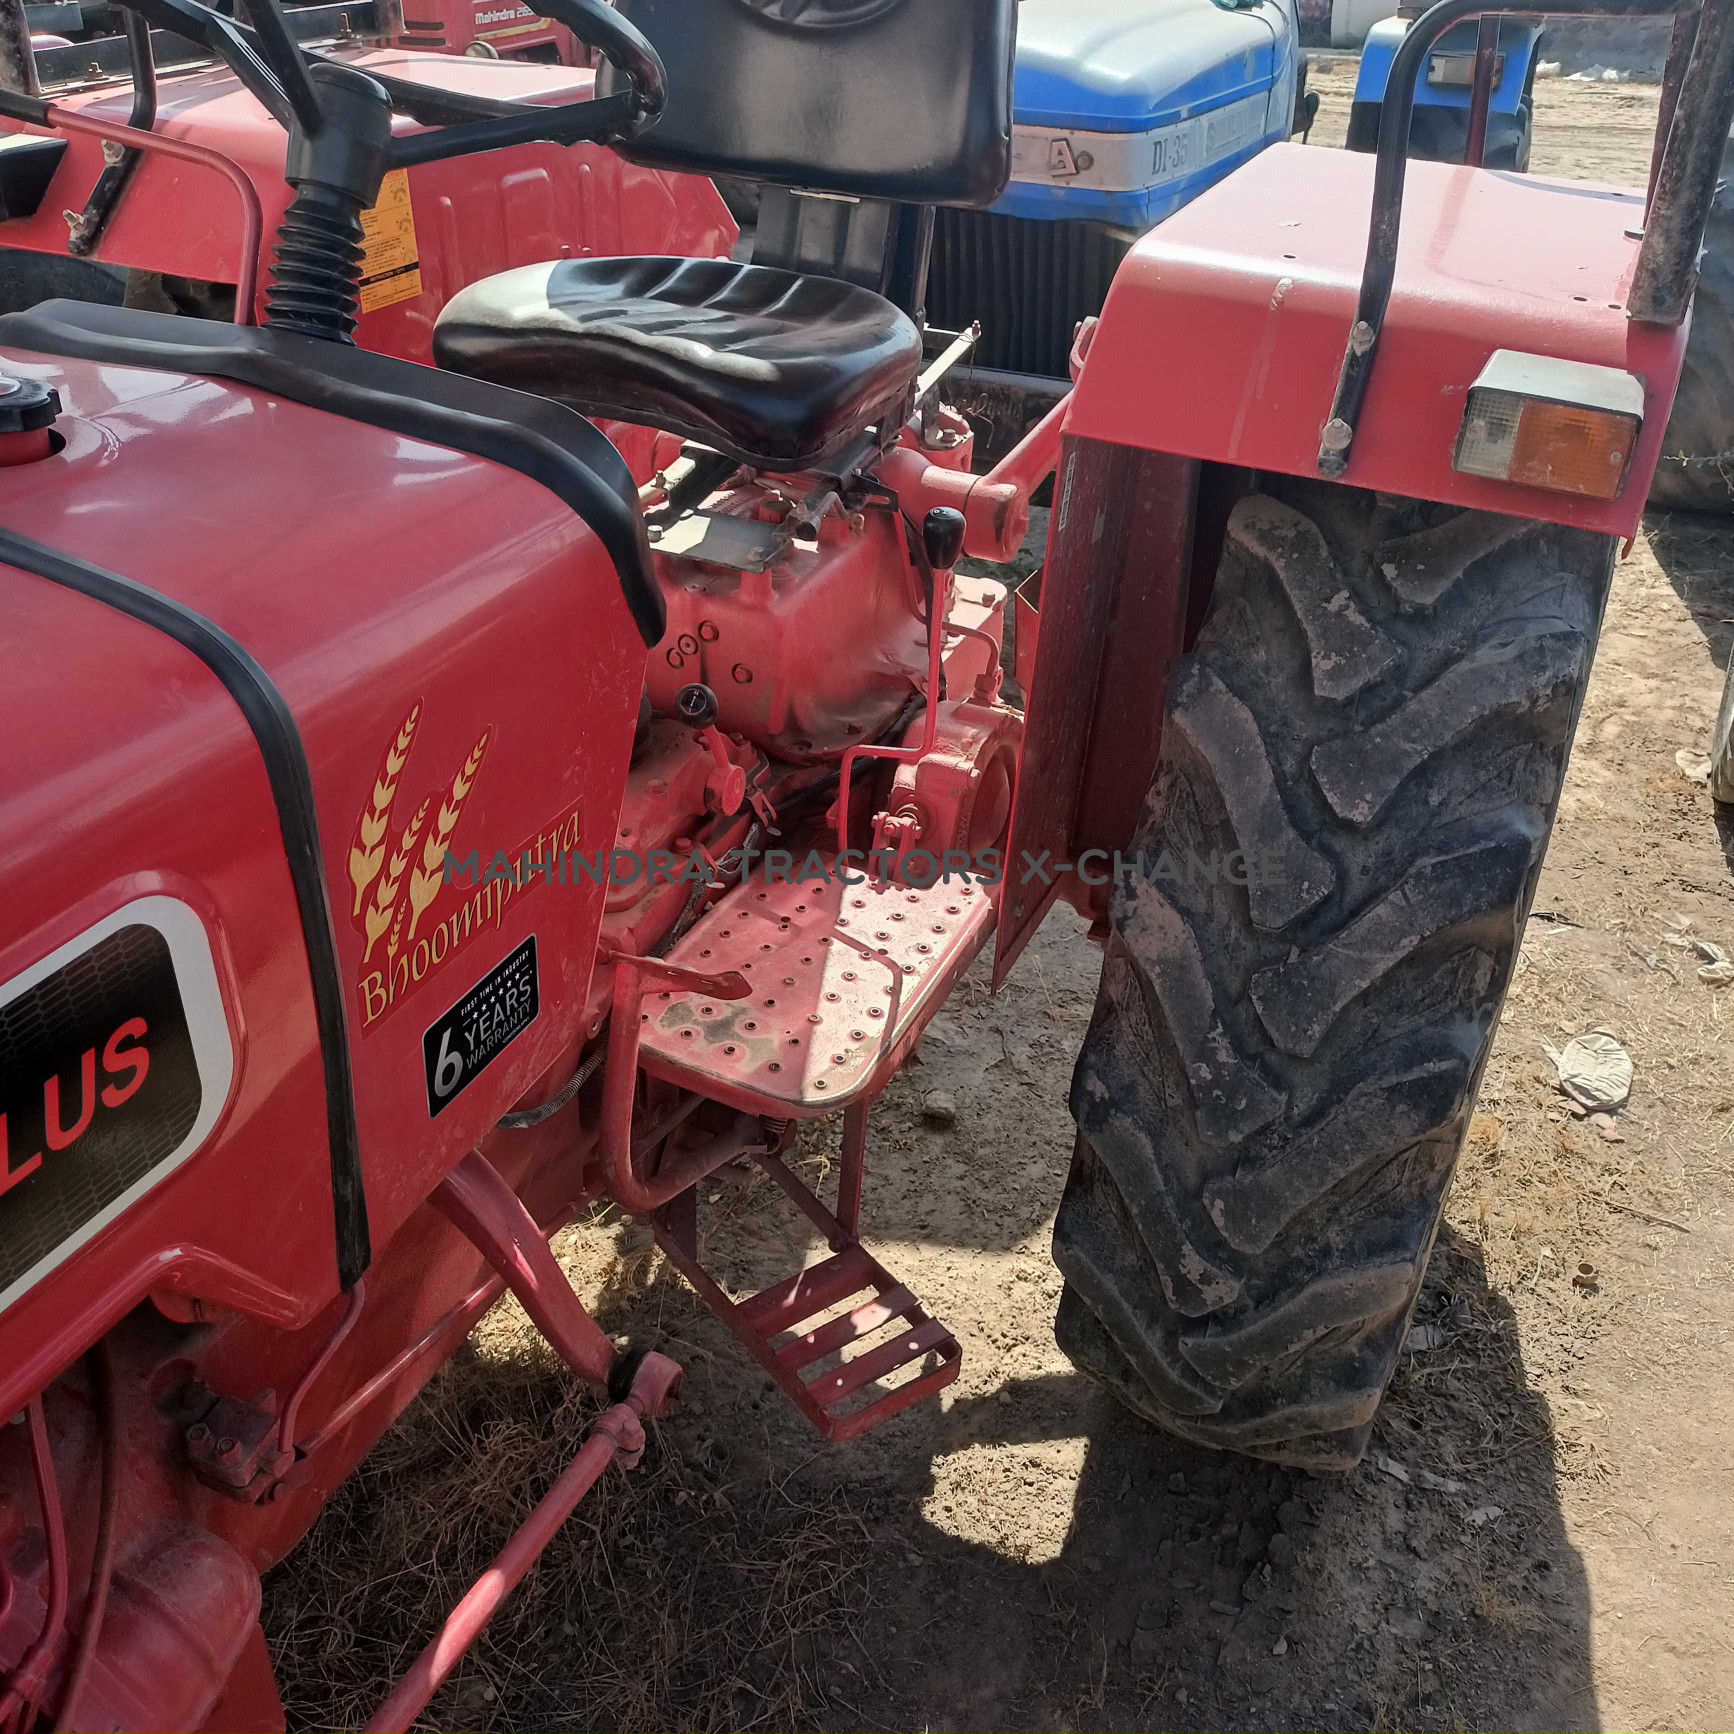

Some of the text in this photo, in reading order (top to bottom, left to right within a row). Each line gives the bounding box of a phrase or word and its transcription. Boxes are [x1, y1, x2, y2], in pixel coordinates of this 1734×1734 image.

[475, 9, 515, 24] Mahindra
[1151, 134, 1187, 175] DI-35
[358, 810, 581, 1028] Bhoomiputra
[461, 950, 529, 1016] FIRST TIME IN INDUSTRY
[434, 1026, 463, 1097] 6
[466, 998, 531, 1070] WARRANTY
